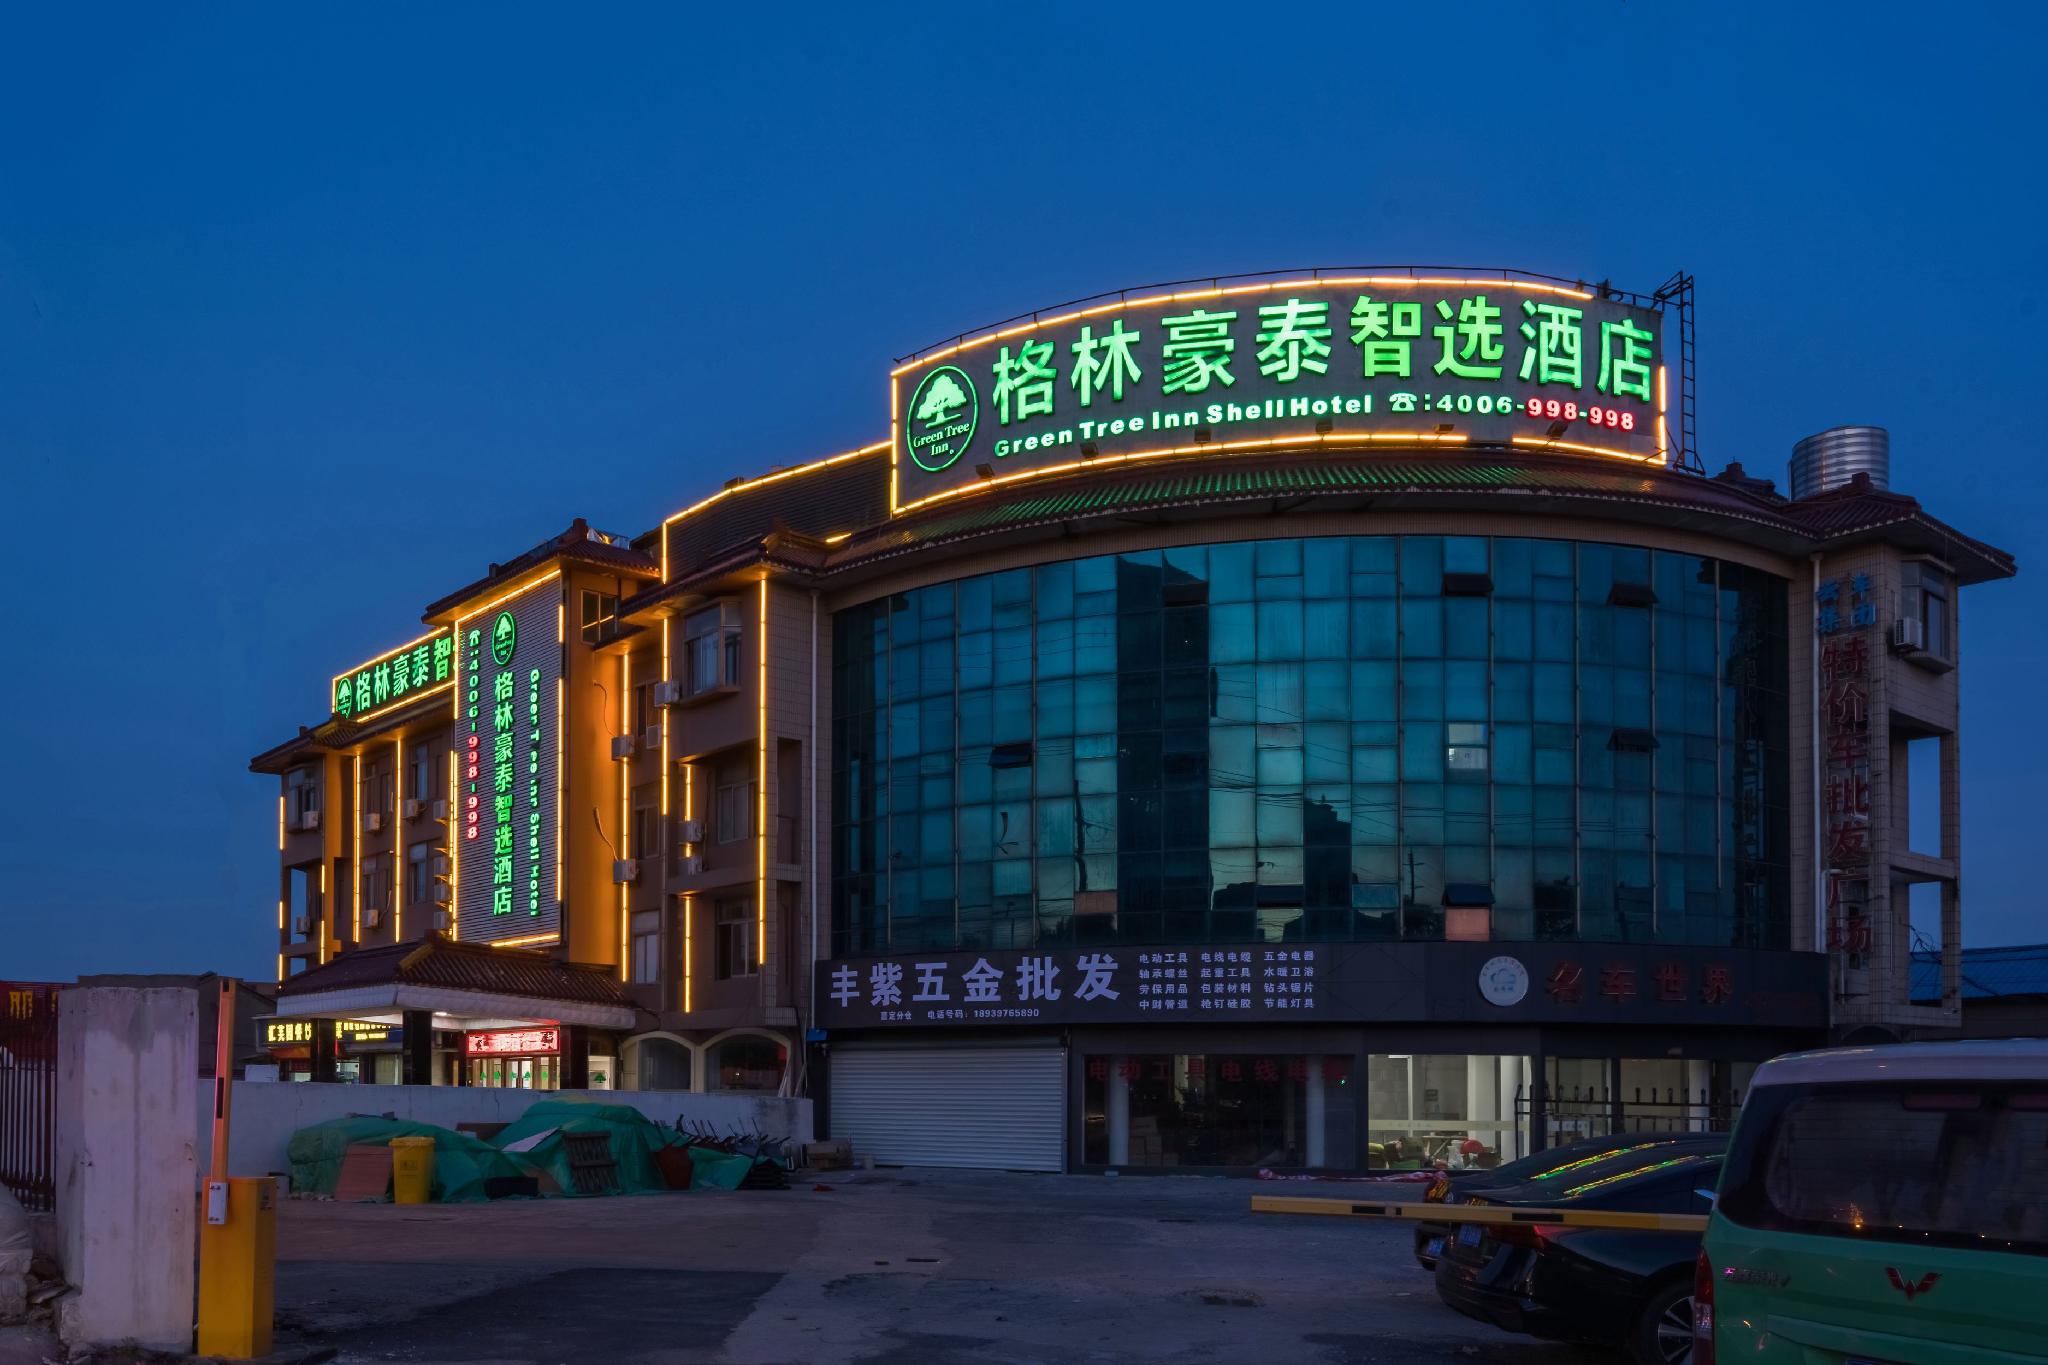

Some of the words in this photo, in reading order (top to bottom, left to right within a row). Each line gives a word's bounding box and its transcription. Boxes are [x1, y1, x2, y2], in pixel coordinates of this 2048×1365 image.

[992, 296, 1653, 425] 格林豪泰智选酒店
[913, 430, 943, 448] Green
[944, 422, 970, 438] Tree
[994, 430, 1073, 457] Green
[1079, 416, 1145, 440] Tree
[1152, 411, 1200, 430] Inn
[1205, 399, 1285, 424] Shell
[1290, 394, 1372, 417] Hotel
[930, 443, 949, 456] Inn
[355, 636, 456, 712] 格林豪泰智
[529, 729, 540, 774] Tee
[493, 672, 514, 916] 格林豪泰智选酒店
[1821, 637, 1873, 952] 特价车批发广场
[529, 813, 540, 859] Shell
[1139, 952, 1188, 964] 电动工具
[1200, 951, 1252, 963] 电线电缆
[1264, 950, 1314, 961] 五金电器
[1139, 968, 1188, 979] 轴承螺丝
[1200, 967, 1252, 978] 起重工具
[1264, 966, 1314, 977] 水暖卫浴
[830, 953, 1120, 1008] 丰紫五金批发
[1139, 984, 1188, 995] 劳保用品
[1200, 983, 1252, 993] 包装材料
[1264, 982, 1314, 993] 钻头锯片
[1139, 999, 1188, 1010] 中财管道
[1200, 998, 1252, 1009] 枪钉硅胶
[1264, 998, 1314, 1009] 节能灯具
